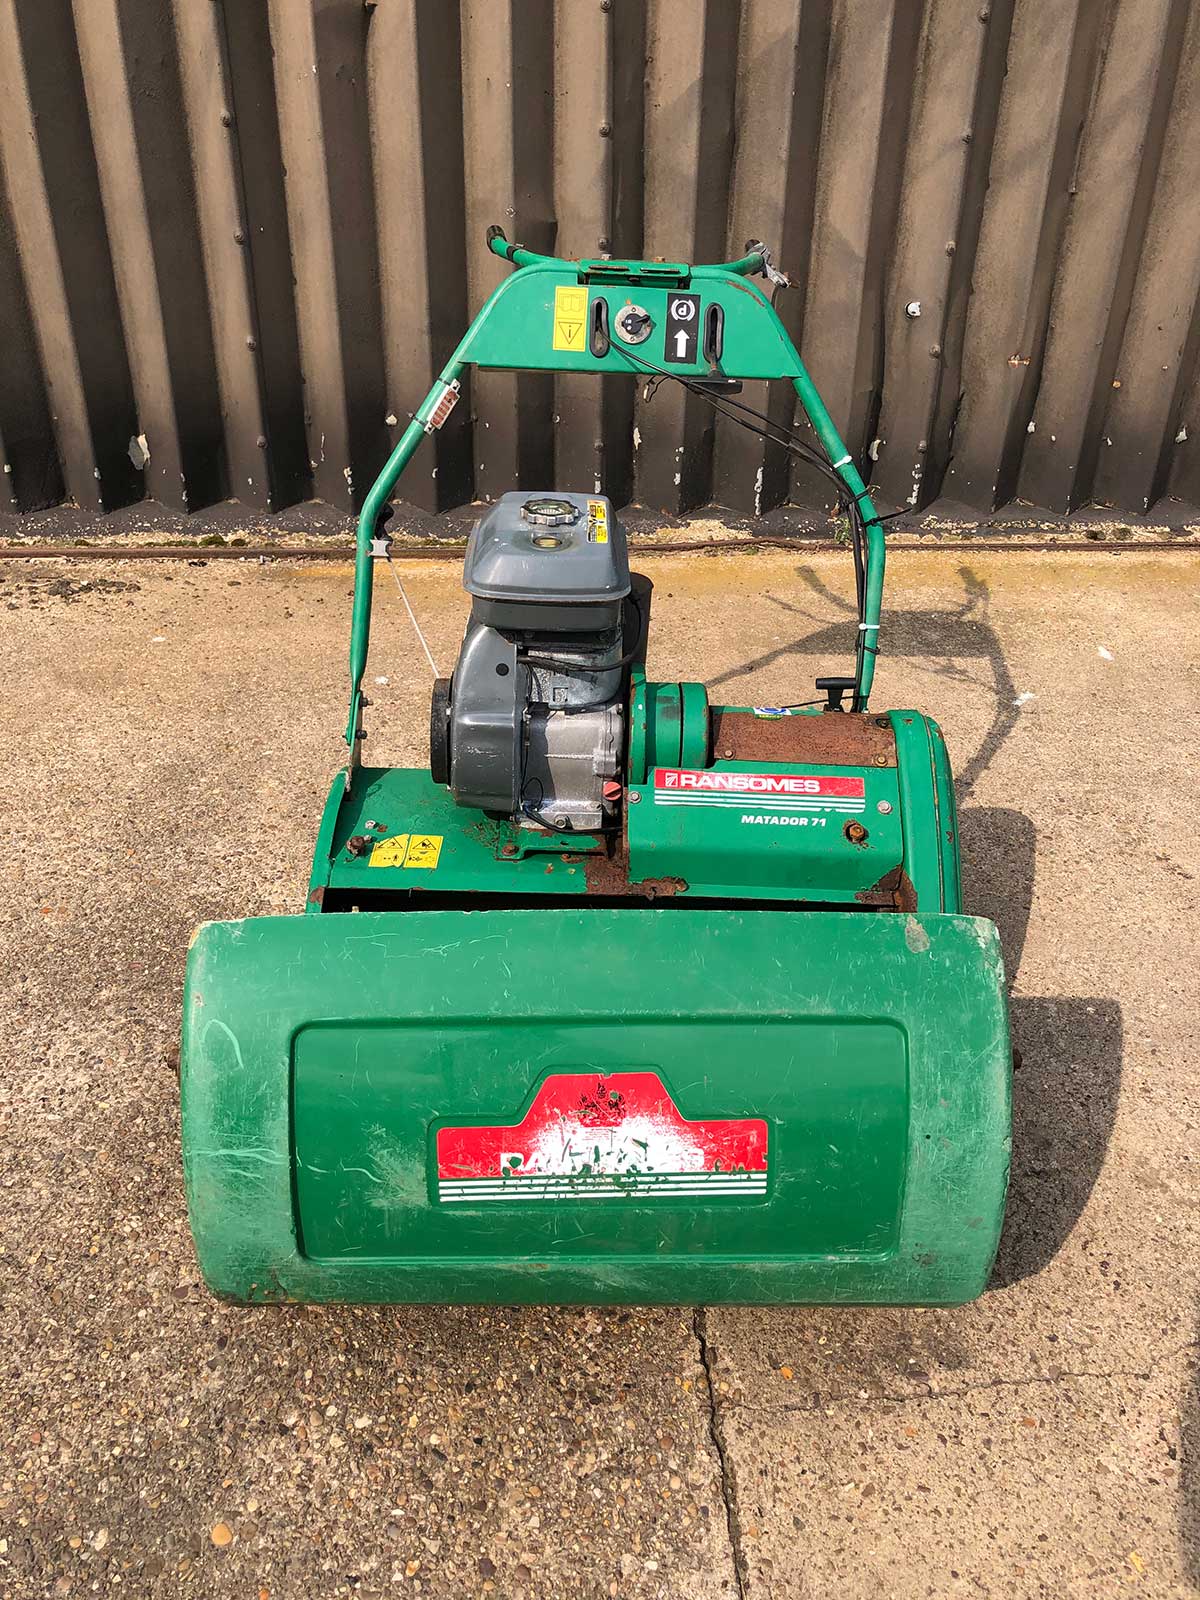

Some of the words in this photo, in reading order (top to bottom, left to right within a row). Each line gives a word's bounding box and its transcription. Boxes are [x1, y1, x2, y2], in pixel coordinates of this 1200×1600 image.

[680, 773, 821, 793] RANSOMES
[741, 815, 808, 826] MATADOR
[811, 817, 827, 827] 71
